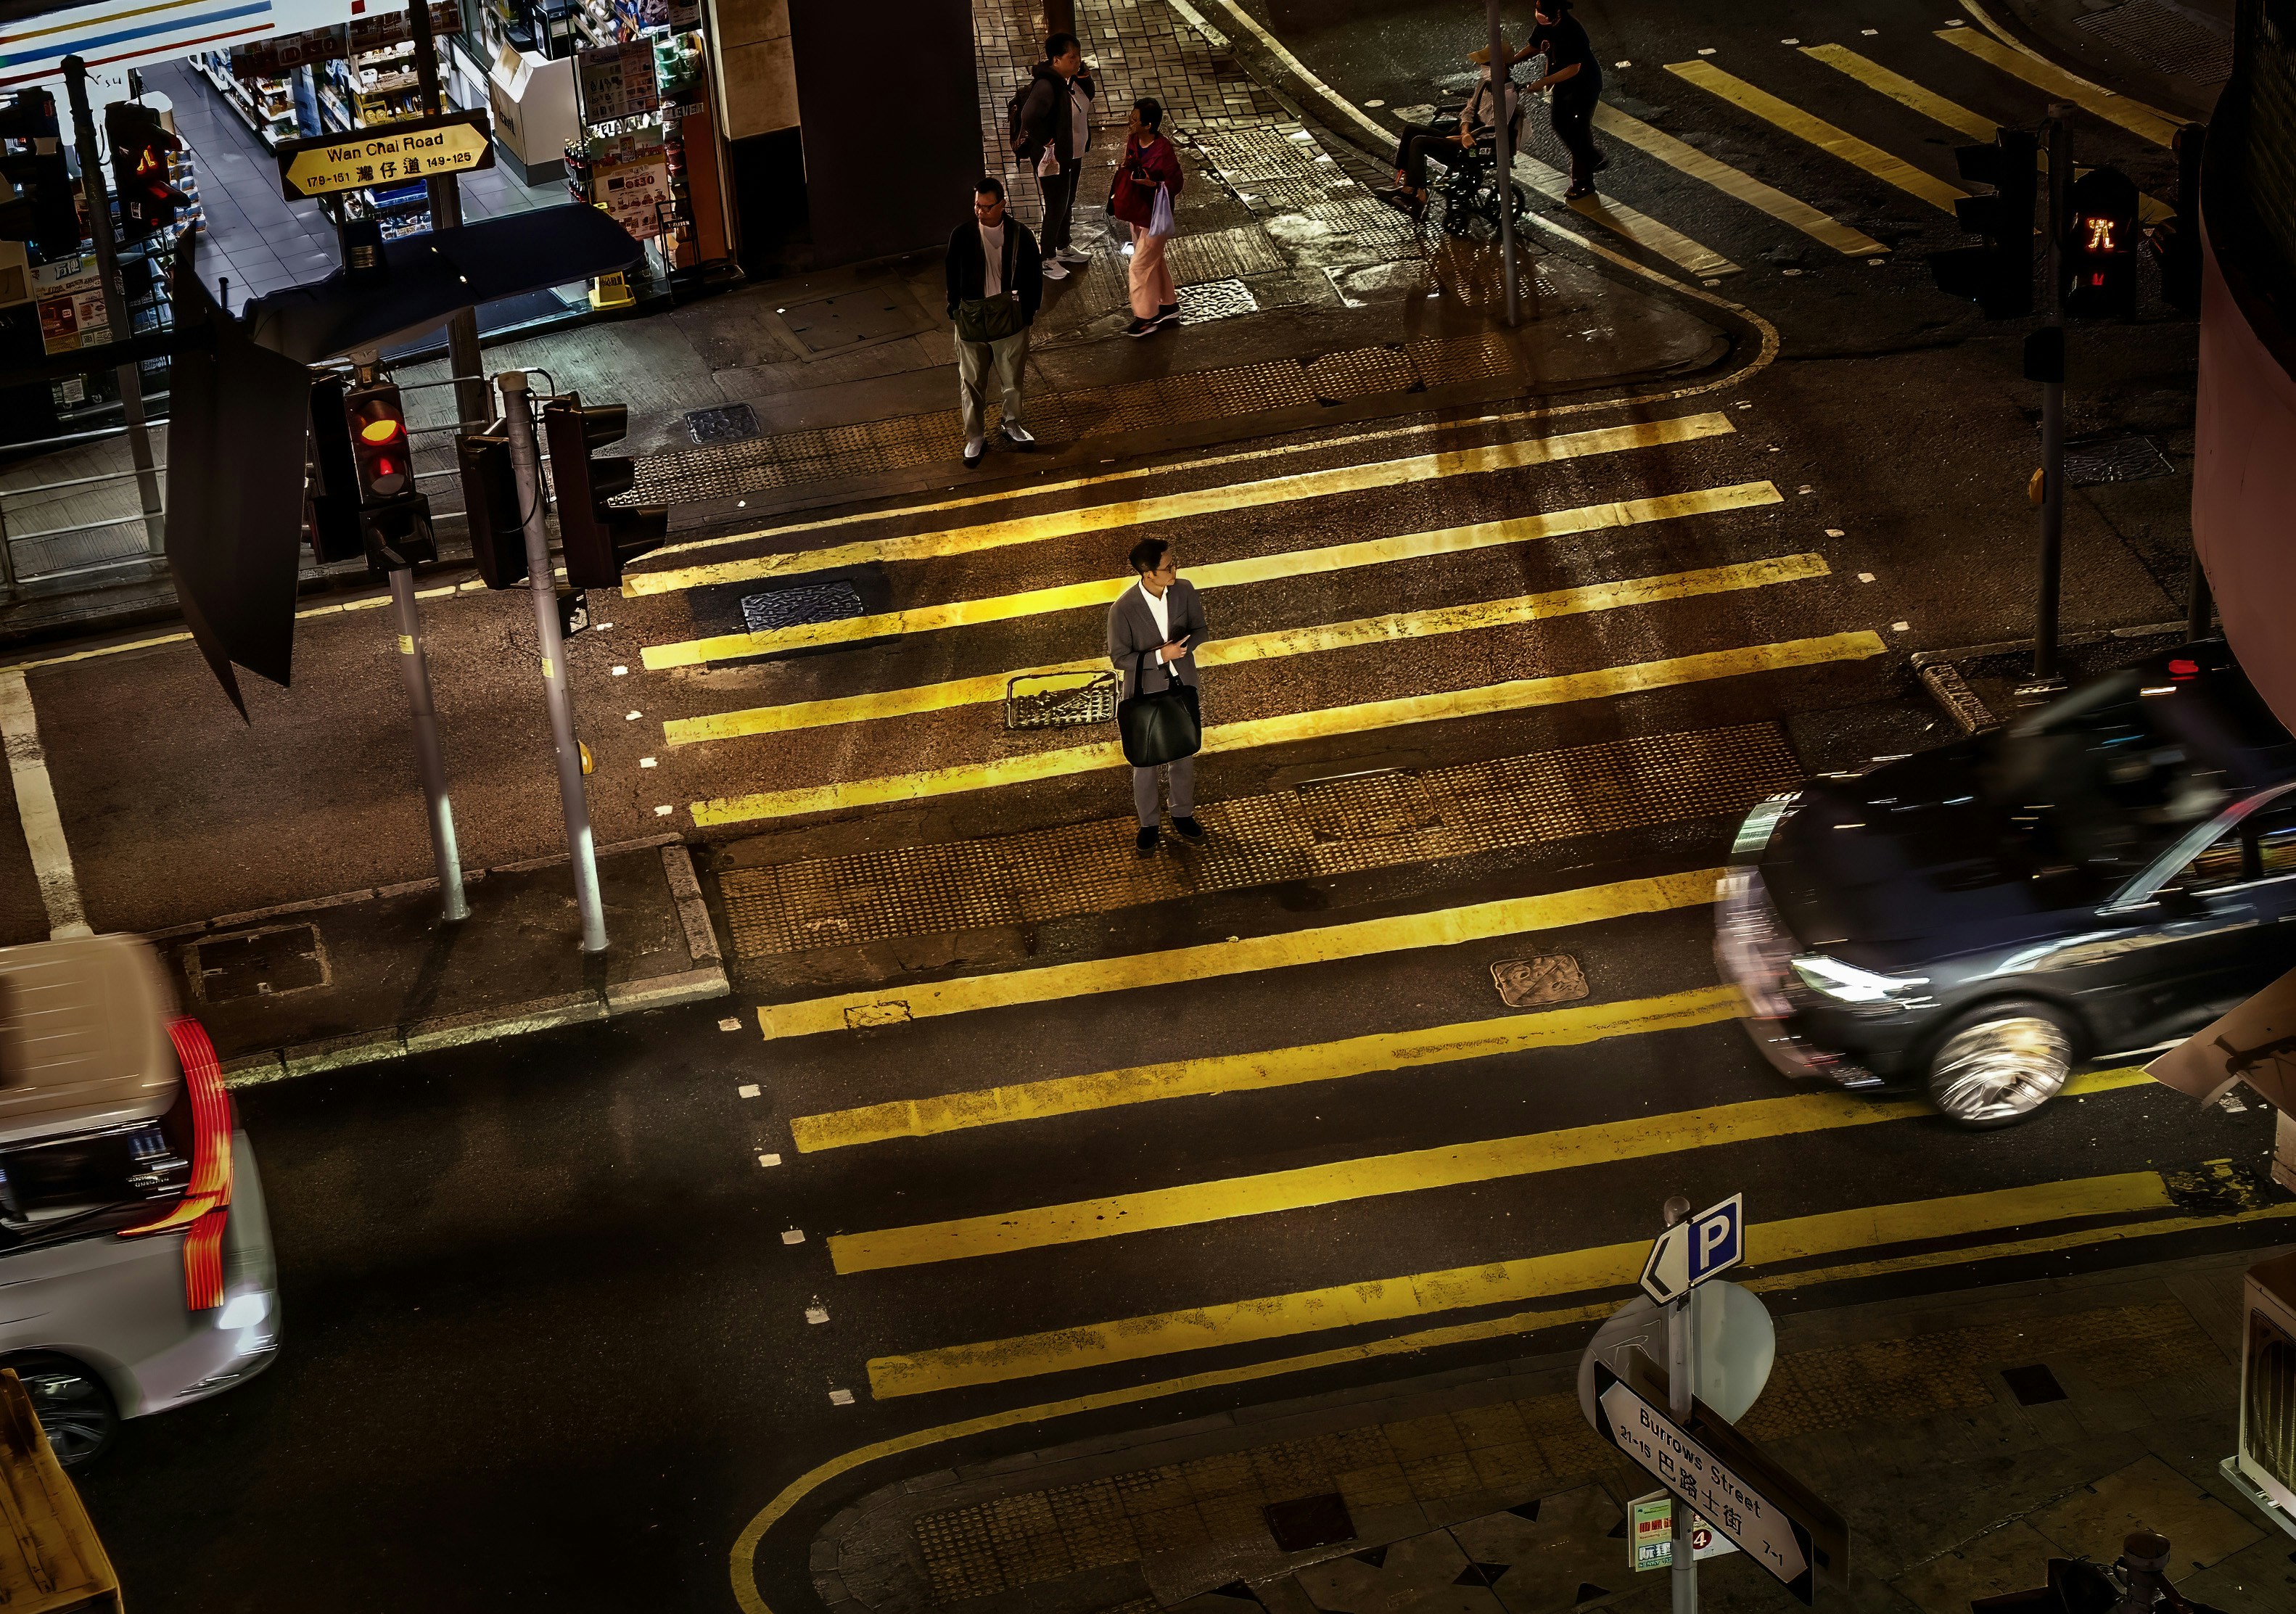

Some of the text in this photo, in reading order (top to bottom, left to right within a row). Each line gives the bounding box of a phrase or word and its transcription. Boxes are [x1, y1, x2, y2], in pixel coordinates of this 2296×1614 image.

[327, 133, 443, 163] Wan Chai Road
[356, 157, 422, 182] 灣仔道
[427, 152, 472, 168] 149-125
[1700, 1215, 1730, 1271] P
[1640, 1407, 1761, 1518] Burrows Street
[1619, 1425, 1651, 1458] 21-15
[1658, 1449, 1742, 1536] 巴路士街
[1762, 1539, 1783, 1567] 7-1
[1693, 1531, 1707, 1547] 4
